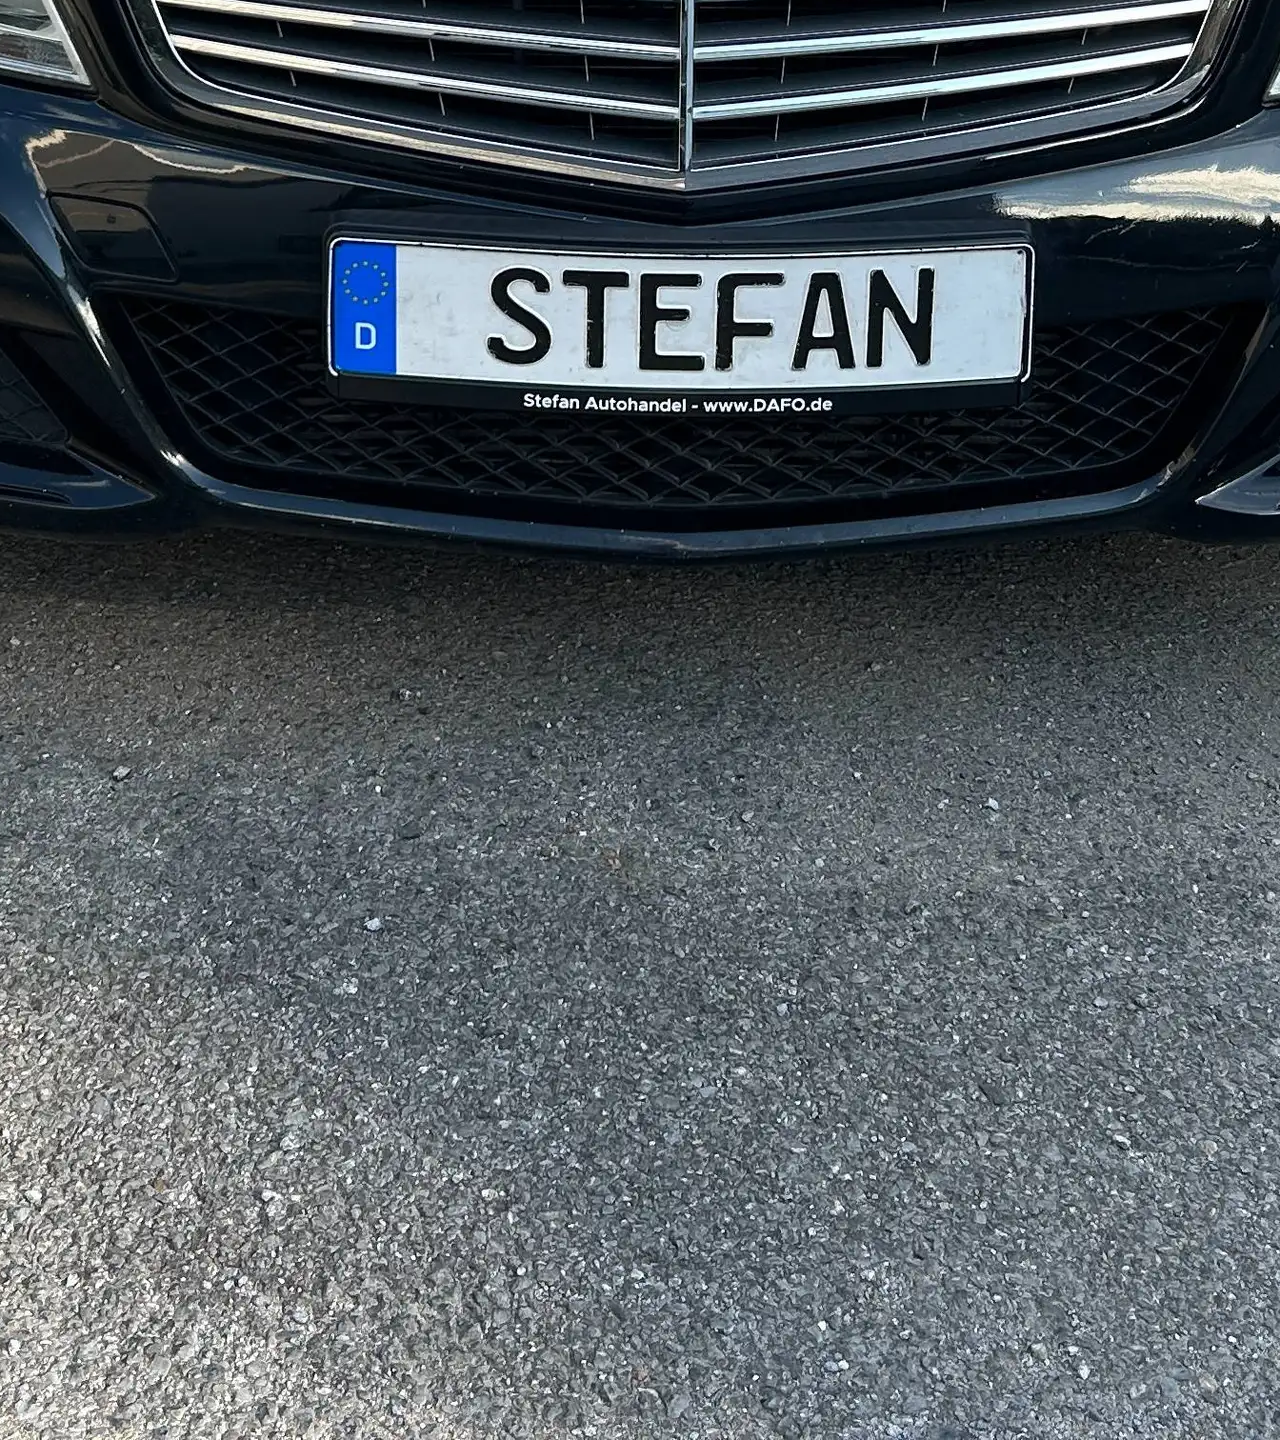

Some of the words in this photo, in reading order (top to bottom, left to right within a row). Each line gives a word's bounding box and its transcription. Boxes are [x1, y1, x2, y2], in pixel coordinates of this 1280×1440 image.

[354, 322, 377, 350] D
[486, 266, 936, 372] STEFAN
[523, 392, 580, 411] Stefan
[585, 395, 687, 413] Autohandel
[703, 397, 833, 412] www.DAFO.de
